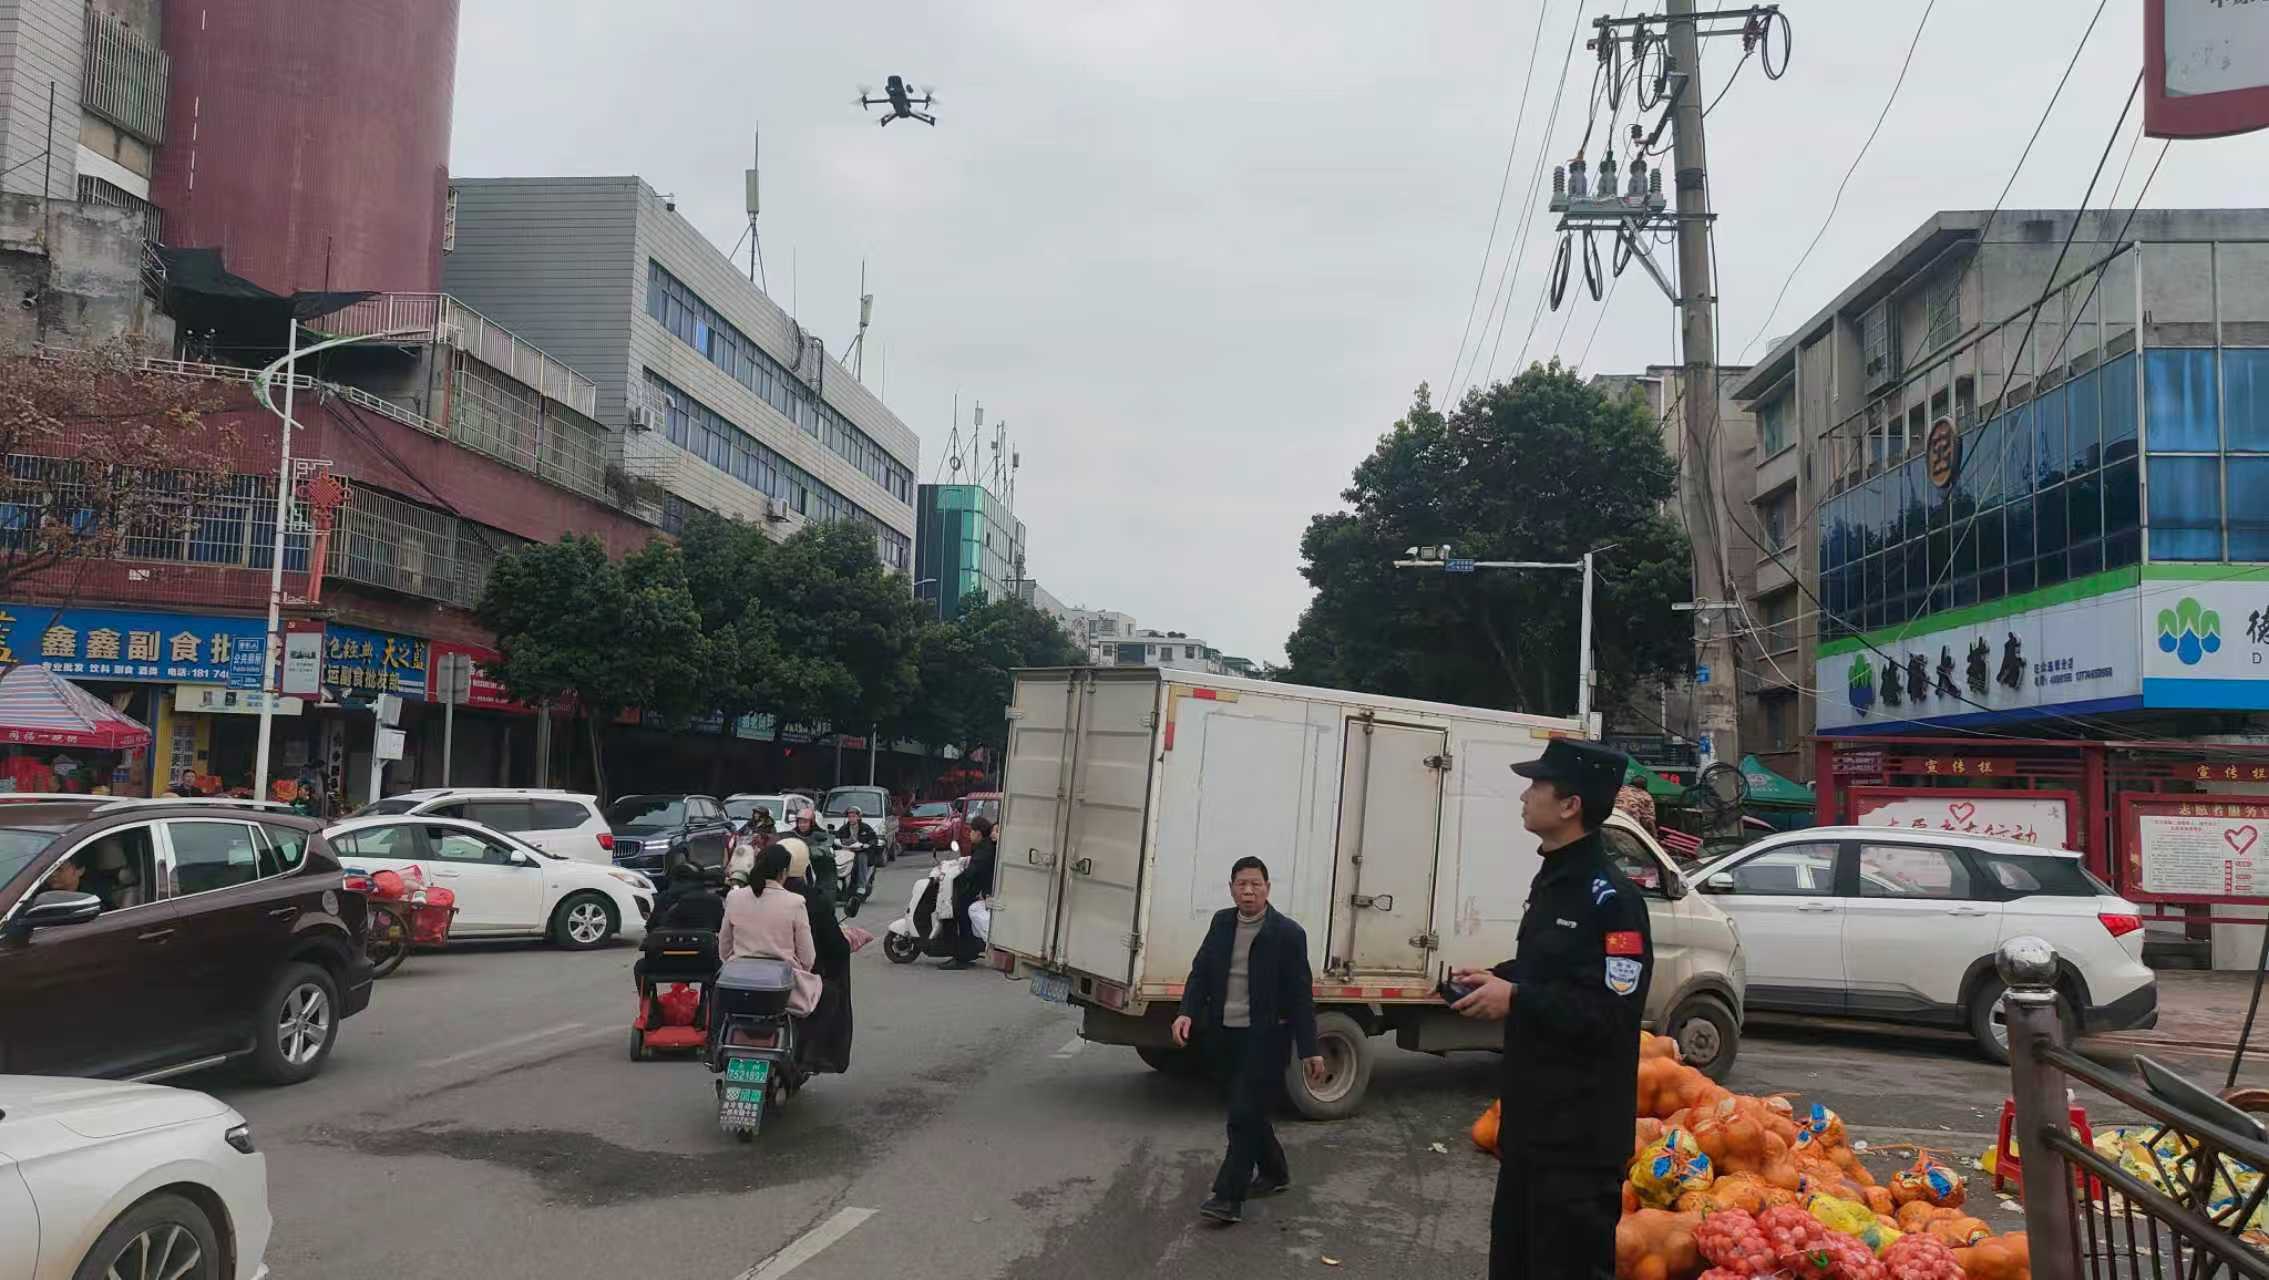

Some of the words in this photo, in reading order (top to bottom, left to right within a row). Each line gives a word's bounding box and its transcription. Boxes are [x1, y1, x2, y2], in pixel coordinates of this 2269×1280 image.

[89, 664, 110, 674] 饮料
[114, 665, 134, 676] 副食
[192, 669, 209, 679] 181
[1926, 759, 1993, 774] 宣传栏
[2197, 765, 2267, 779] 宣传栏
